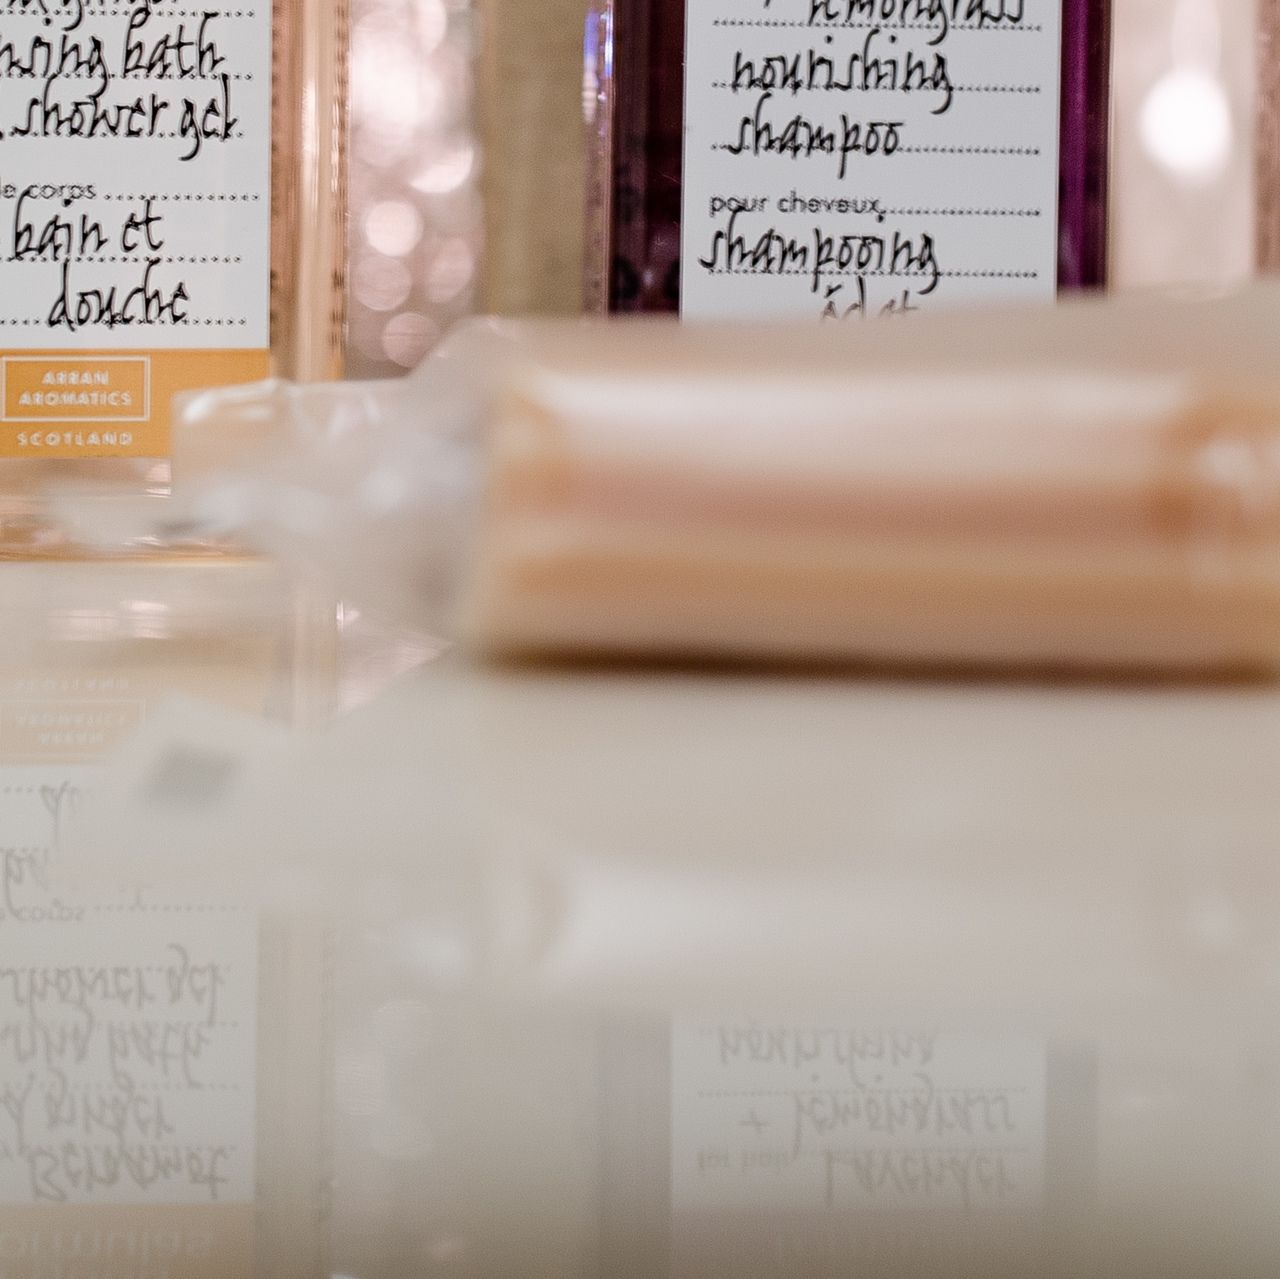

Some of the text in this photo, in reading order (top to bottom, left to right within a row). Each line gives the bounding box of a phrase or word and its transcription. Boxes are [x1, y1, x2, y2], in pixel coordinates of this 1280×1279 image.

[123, 7, 228, 76] bath
[731, 29, 953, 115] nourishing
[15, 77, 168, 138] shower
[178, 74, 234, 160] gel
[729, 92, 904, 180] shampoo
[14, 189, 108, 261] bain
[121, 200, 165, 252] et
[26, 182, 97, 205] corps
[710, 188, 880, 218] pour cheveux
[698, 206, 941, 296] shampooing
[47, 258, 190, 330] douche
[19, 391, 132, 407] AROMATICS
[42, 370, 110, 386] ARRAN
[16, 431, 134, 448] SCOTLAND
